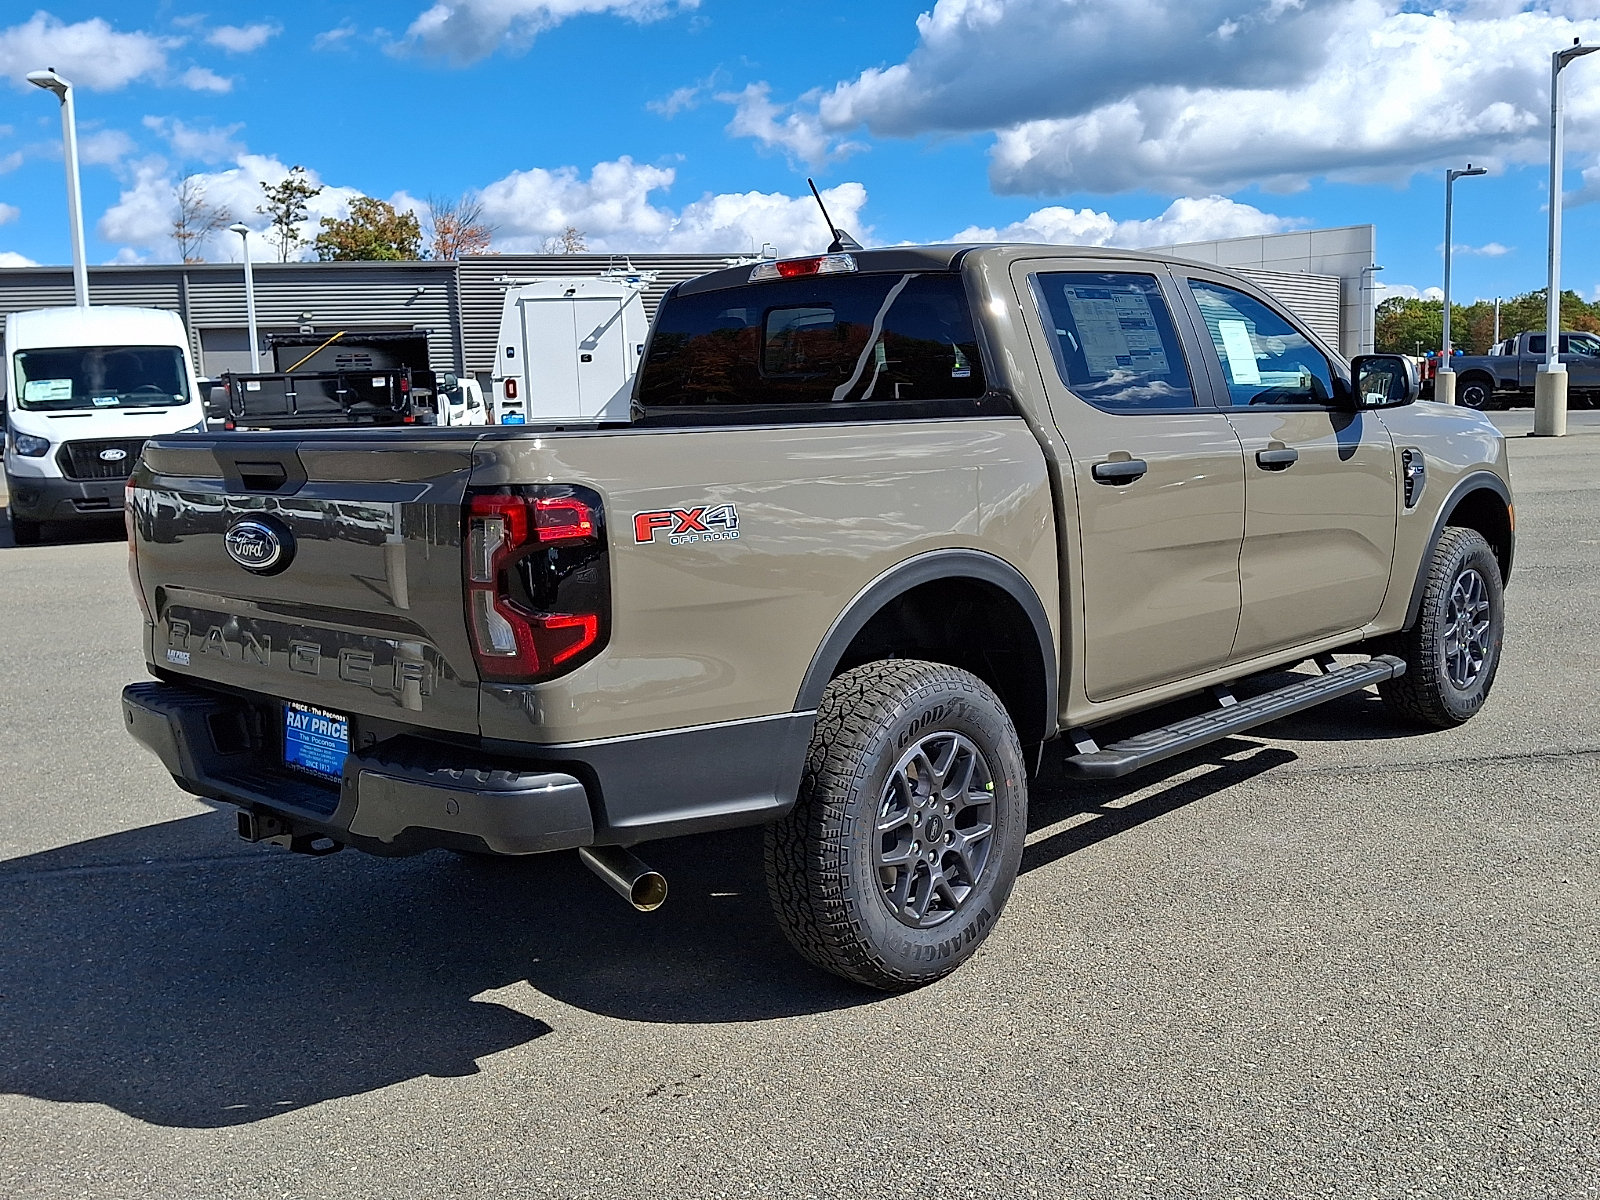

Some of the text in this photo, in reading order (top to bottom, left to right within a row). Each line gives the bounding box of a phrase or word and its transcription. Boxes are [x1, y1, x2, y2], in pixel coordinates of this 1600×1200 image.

[632, 503, 740, 544] FX4
[669, 530, 740, 546] OFF ROAD
[168, 617, 433, 697] RANGER
[287, 711, 348, 740] RAY PRICE
[300, 733, 336, 748] The Poconos
